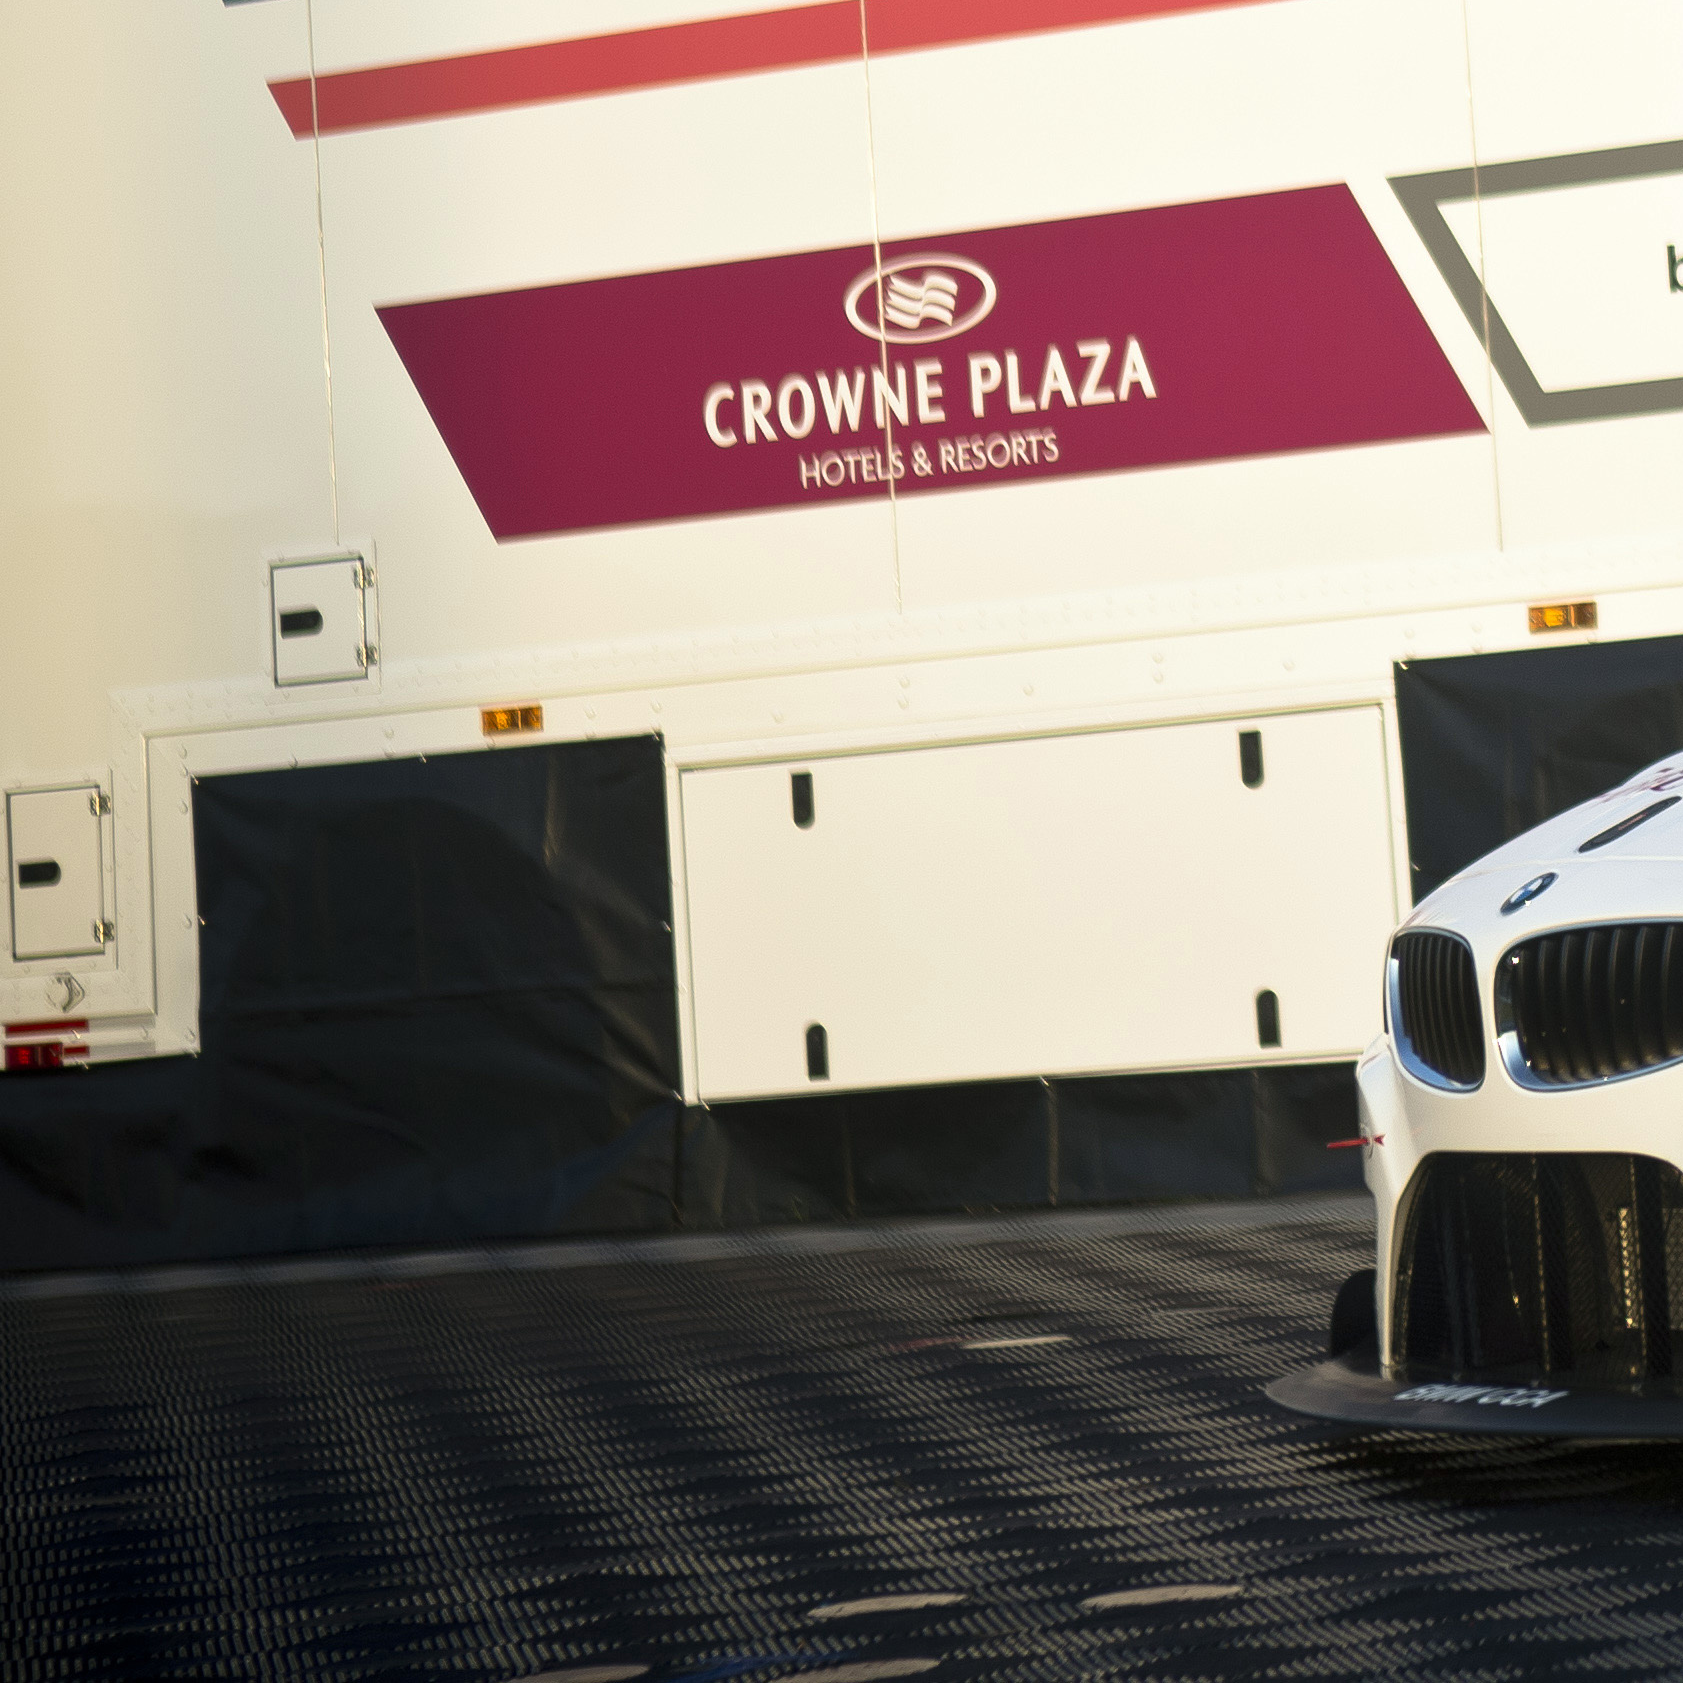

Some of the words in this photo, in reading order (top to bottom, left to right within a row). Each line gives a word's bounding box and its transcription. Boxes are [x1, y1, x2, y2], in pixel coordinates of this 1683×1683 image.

[703, 356, 947, 448] CROWNE
[968, 334, 1158, 419] PLAZA
[800, 447, 905, 490] HOTELS
[912, 441, 935, 477] &
[939, 426, 1060, 474] RESORTS
